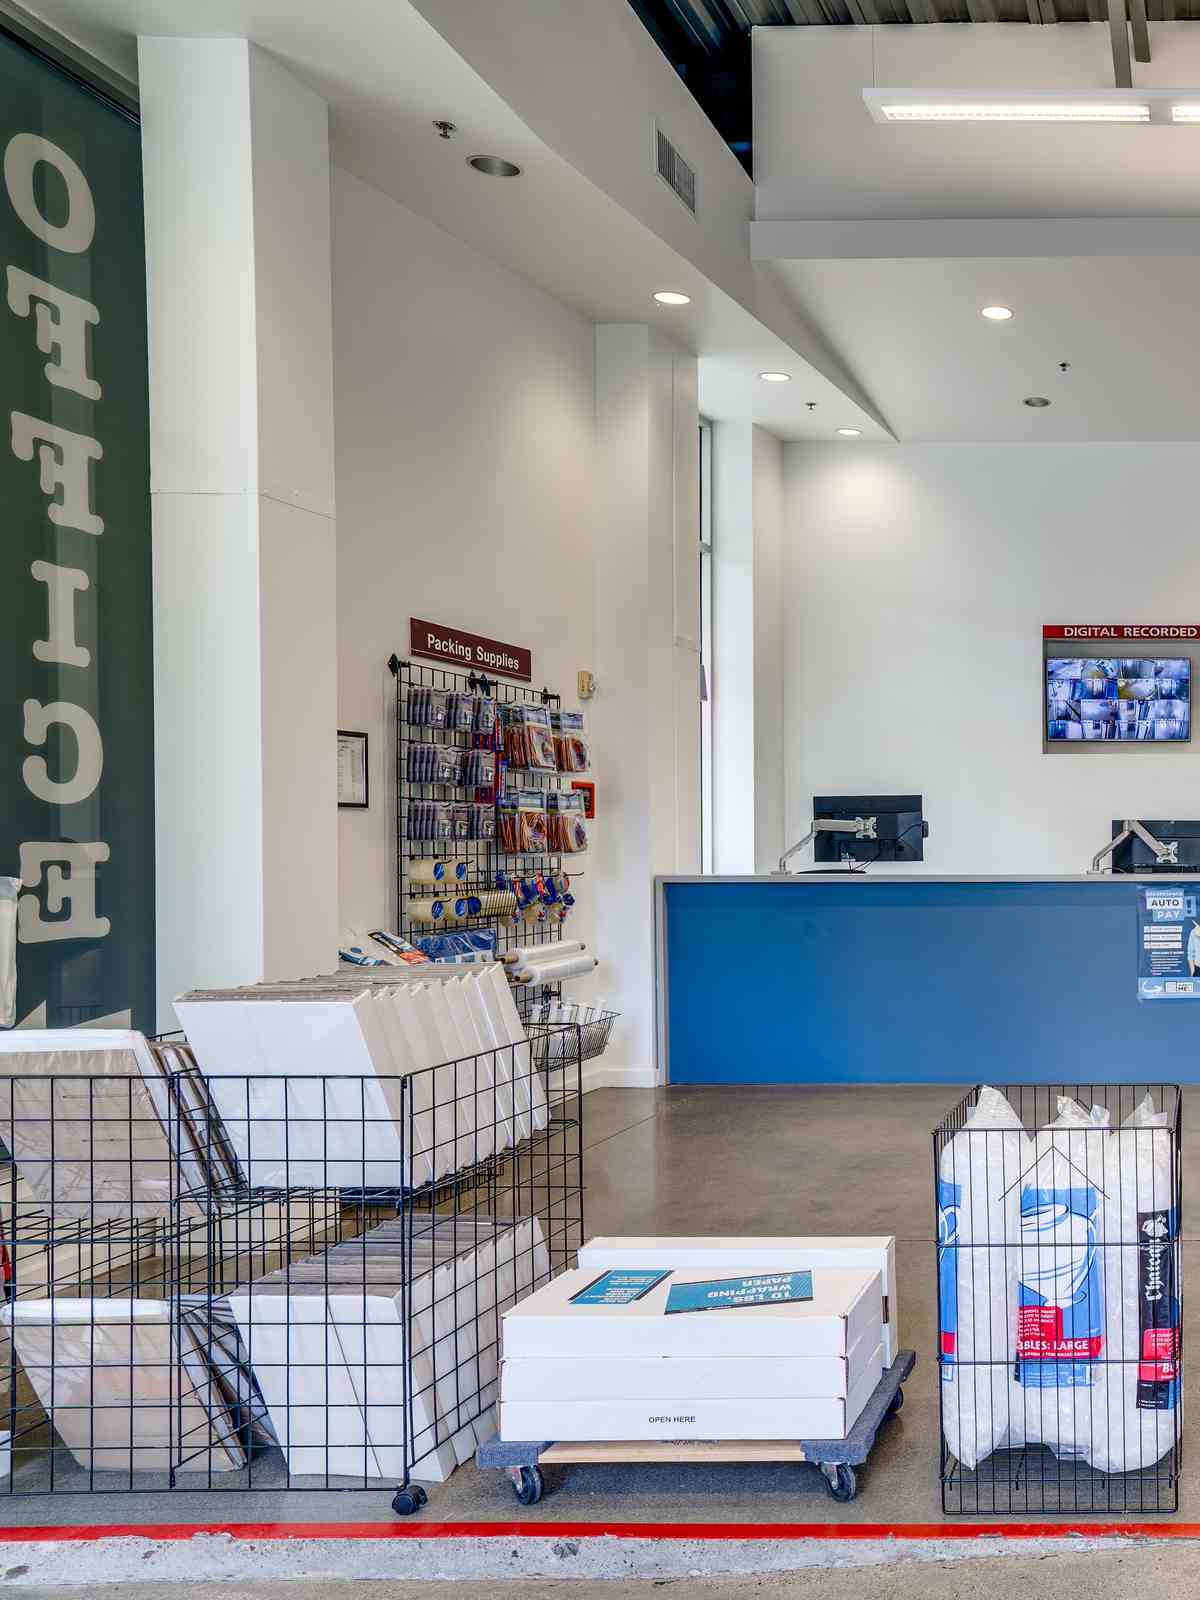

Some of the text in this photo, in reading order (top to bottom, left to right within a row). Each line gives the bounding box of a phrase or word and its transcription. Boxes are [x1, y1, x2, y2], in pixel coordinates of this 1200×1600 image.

[1064, 627, 1118, 637] DIGITAL
[1123, 627, 1198, 637] RECORDED
[427, 633, 519, 670] Packing Supplies
[1151, 899, 1180, 907] AUTO
[1157, 910, 1180, 919] PAY
[742, 1276, 792, 1287] PAPER
[707, 1284, 792, 1298] WRAPPING
[1053, 1340, 1089, 1351] LARGE
[648, 1415, 697, 1424] OPEN HERE
